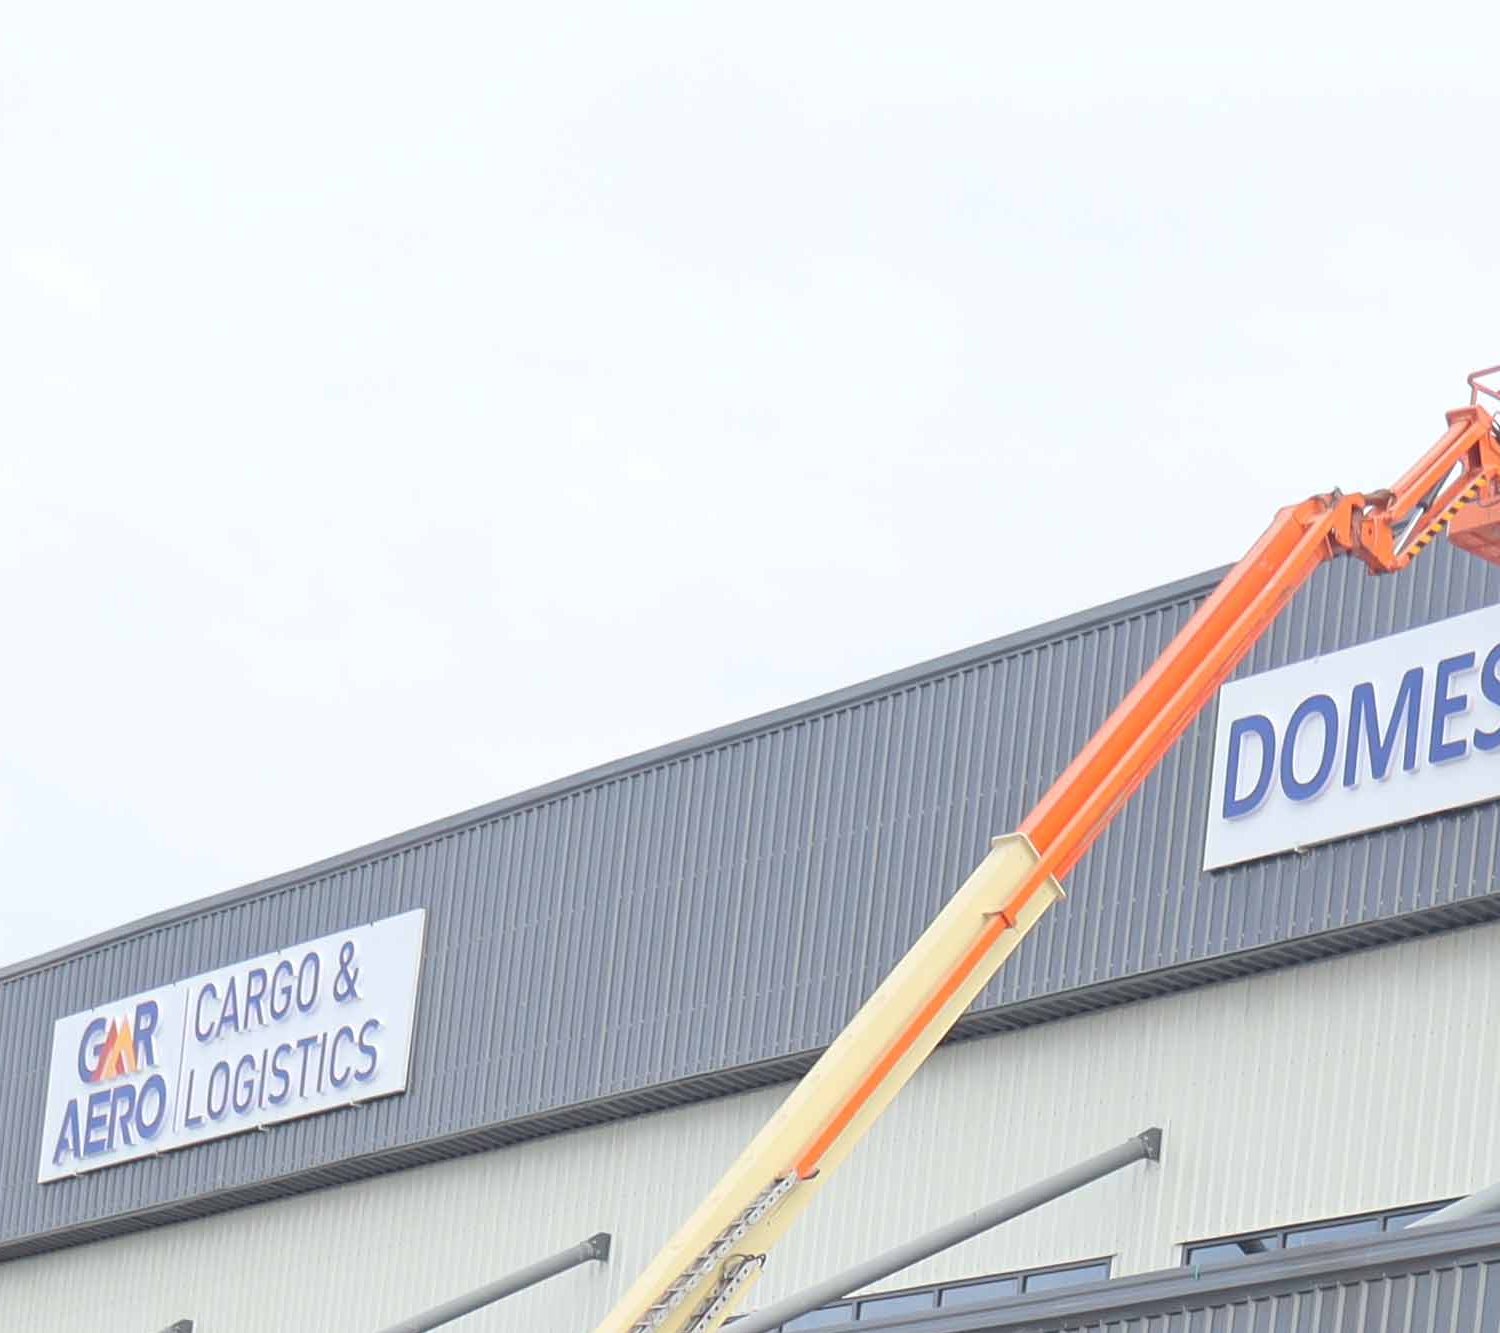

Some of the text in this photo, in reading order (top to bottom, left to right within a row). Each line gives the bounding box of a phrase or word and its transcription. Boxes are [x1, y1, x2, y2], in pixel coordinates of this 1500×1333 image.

[194, 940, 360, 1043] CARGO &
[77, 999, 159, 1084] GMR
[184, 1018, 380, 1129] LOGISTICS
[51, 1074, 167, 1165] AERO
